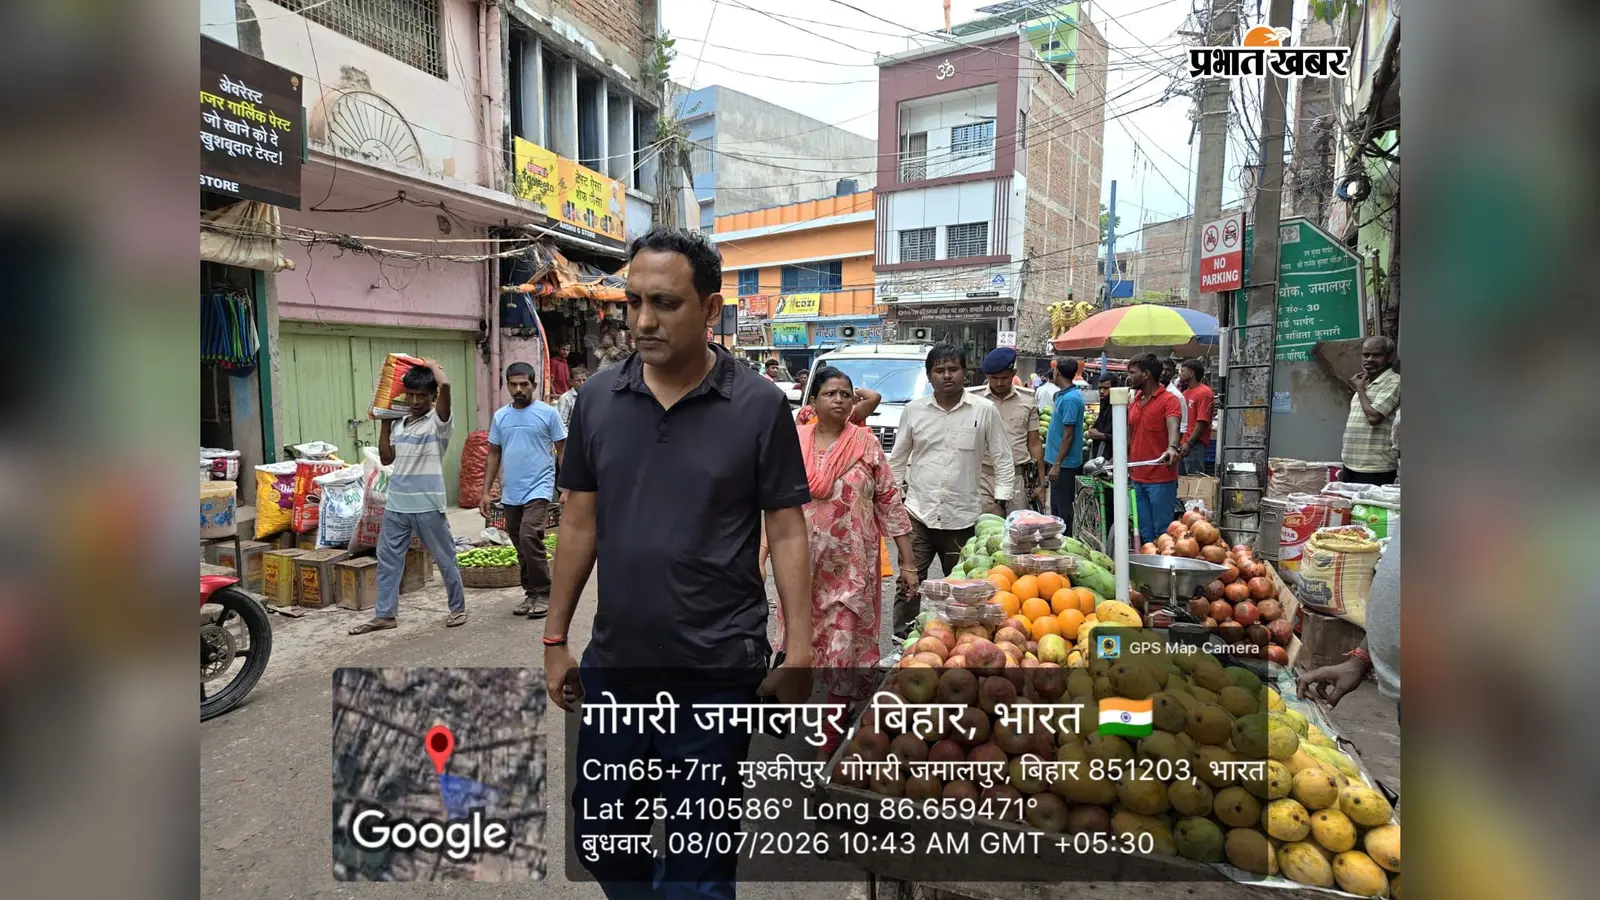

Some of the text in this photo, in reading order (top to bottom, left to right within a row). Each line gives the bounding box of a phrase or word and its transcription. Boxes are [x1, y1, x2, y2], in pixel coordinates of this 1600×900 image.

[227, 101, 267, 125] गार्लिक
[268, 110, 291, 132] पेस्ट
[203, 110, 279, 147] जो खाने को दे
[200, 131, 283, 166] खुशबूदार टेस्ट!
[1213, 257, 1226, 270] NO
[1202, 270, 1238, 286] PARKING
[1308, 279, 1352, 295] जमालपुर
[1307, 303, 1320, 312] 30
[1285, 330, 1311, 340] सविता
[1314, 325, 1340, 340] कुमारी
